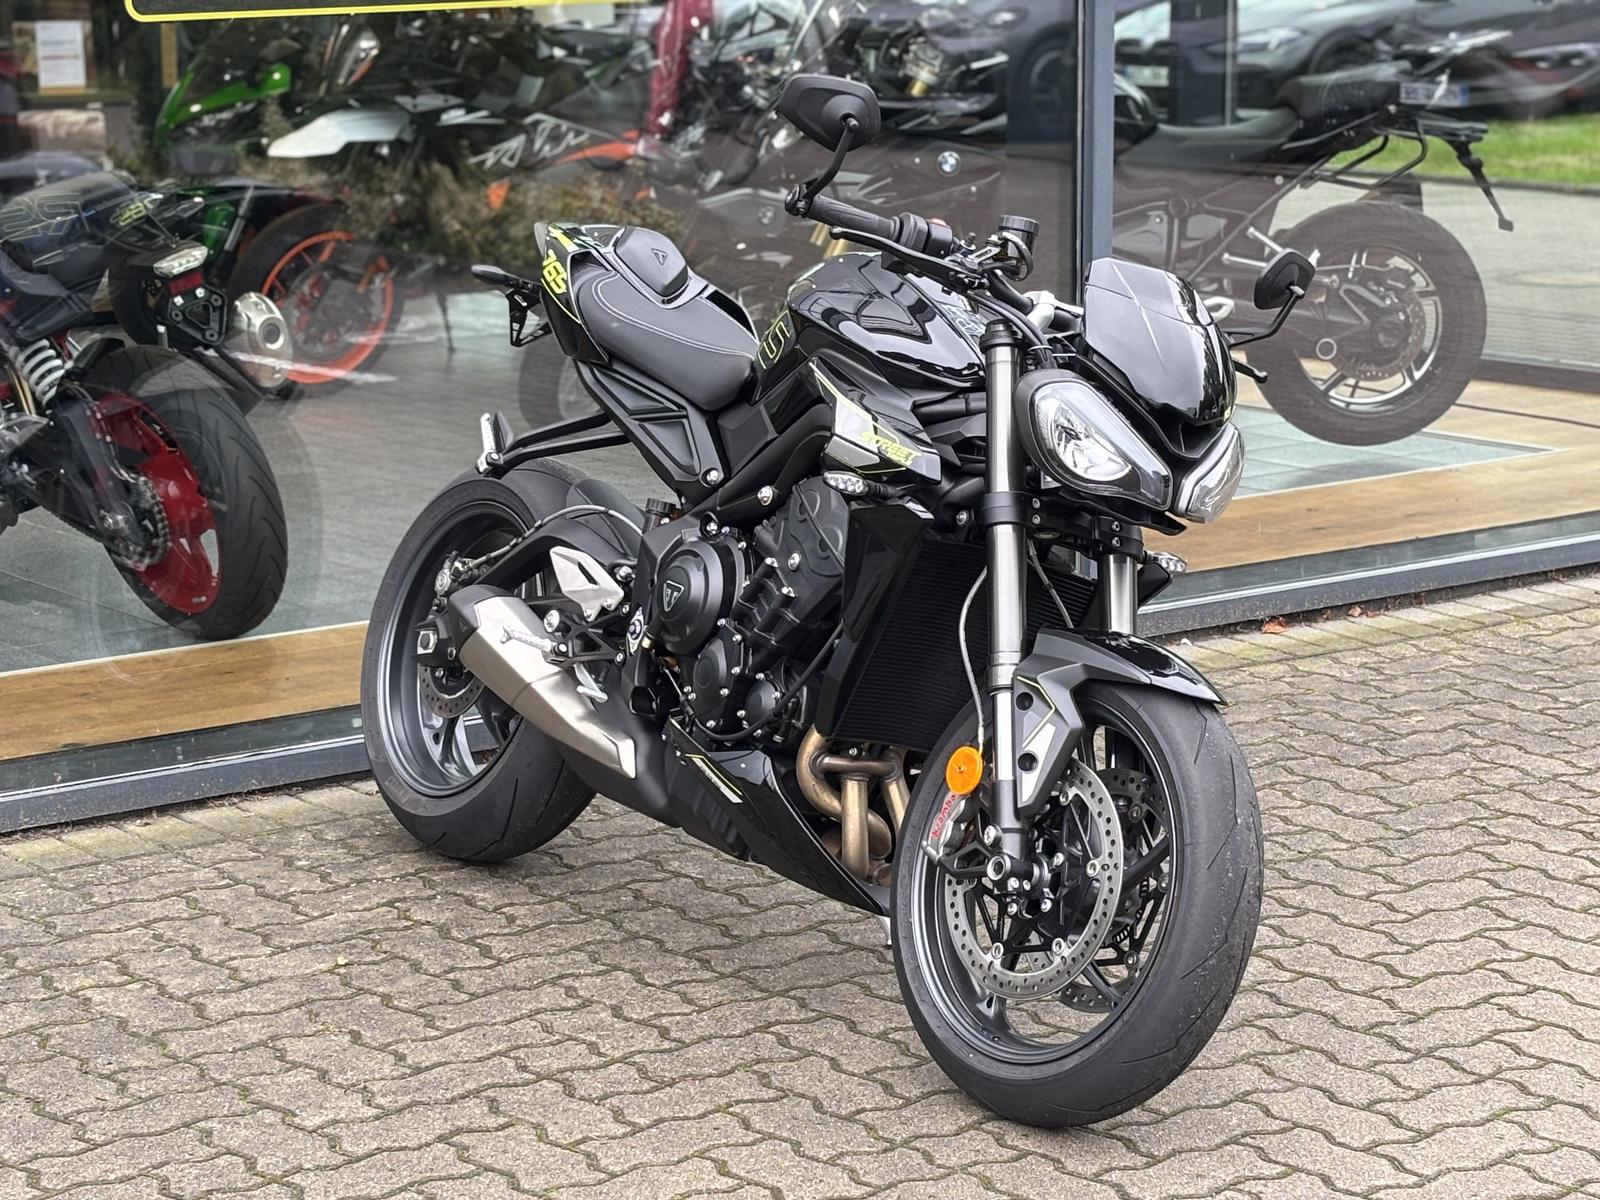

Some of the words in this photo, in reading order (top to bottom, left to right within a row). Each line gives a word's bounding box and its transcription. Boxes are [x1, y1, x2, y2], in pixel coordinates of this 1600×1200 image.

[542, 248, 567, 294] 765
[859, 431, 922, 462] STREET
[931, 794, 957, 838] brembo
